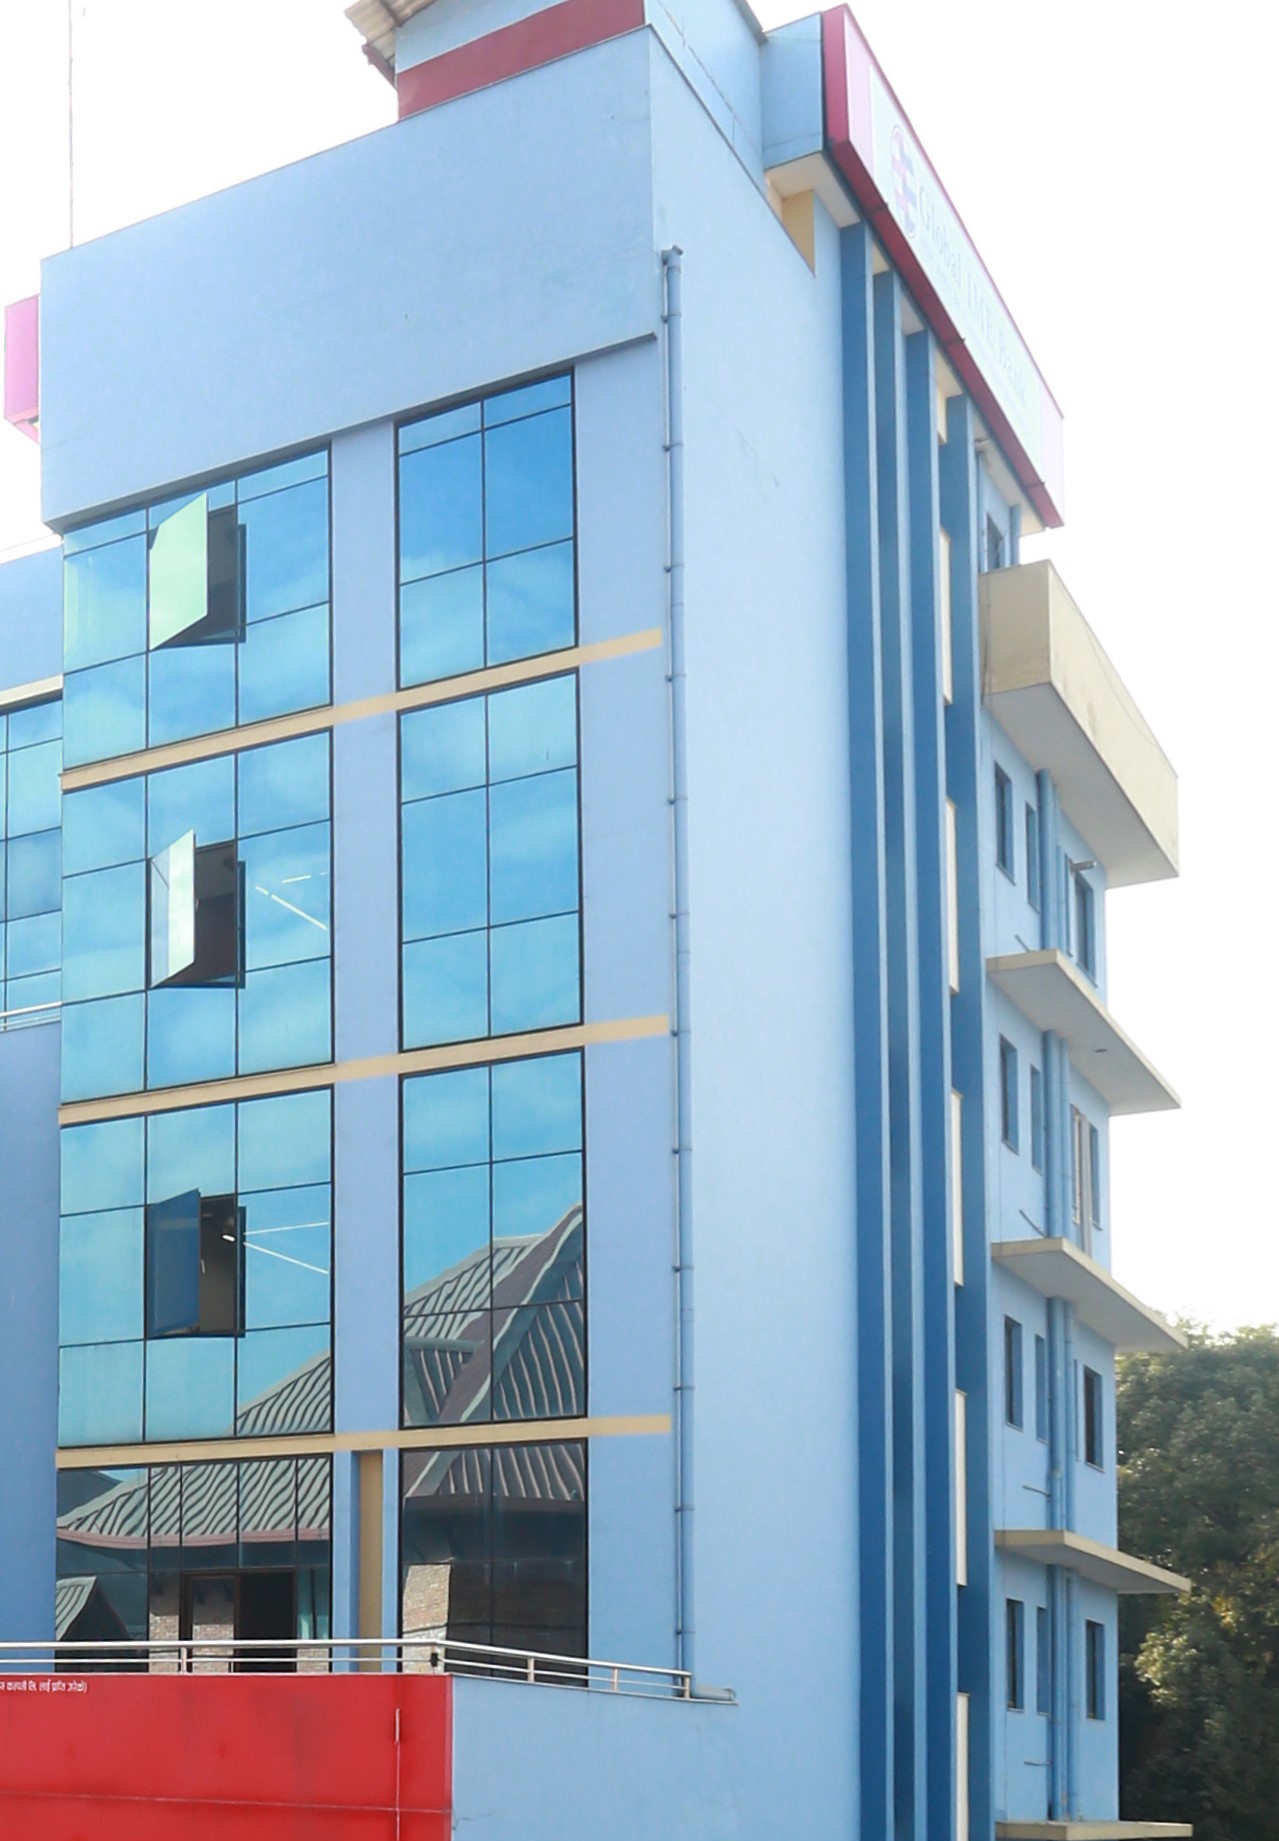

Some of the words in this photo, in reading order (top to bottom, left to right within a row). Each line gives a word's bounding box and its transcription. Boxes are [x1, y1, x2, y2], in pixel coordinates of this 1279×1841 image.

[919, 185, 962, 288] Global
[966, 270, 996, 350] IME
[998, 330, 1028, 410] Bank
